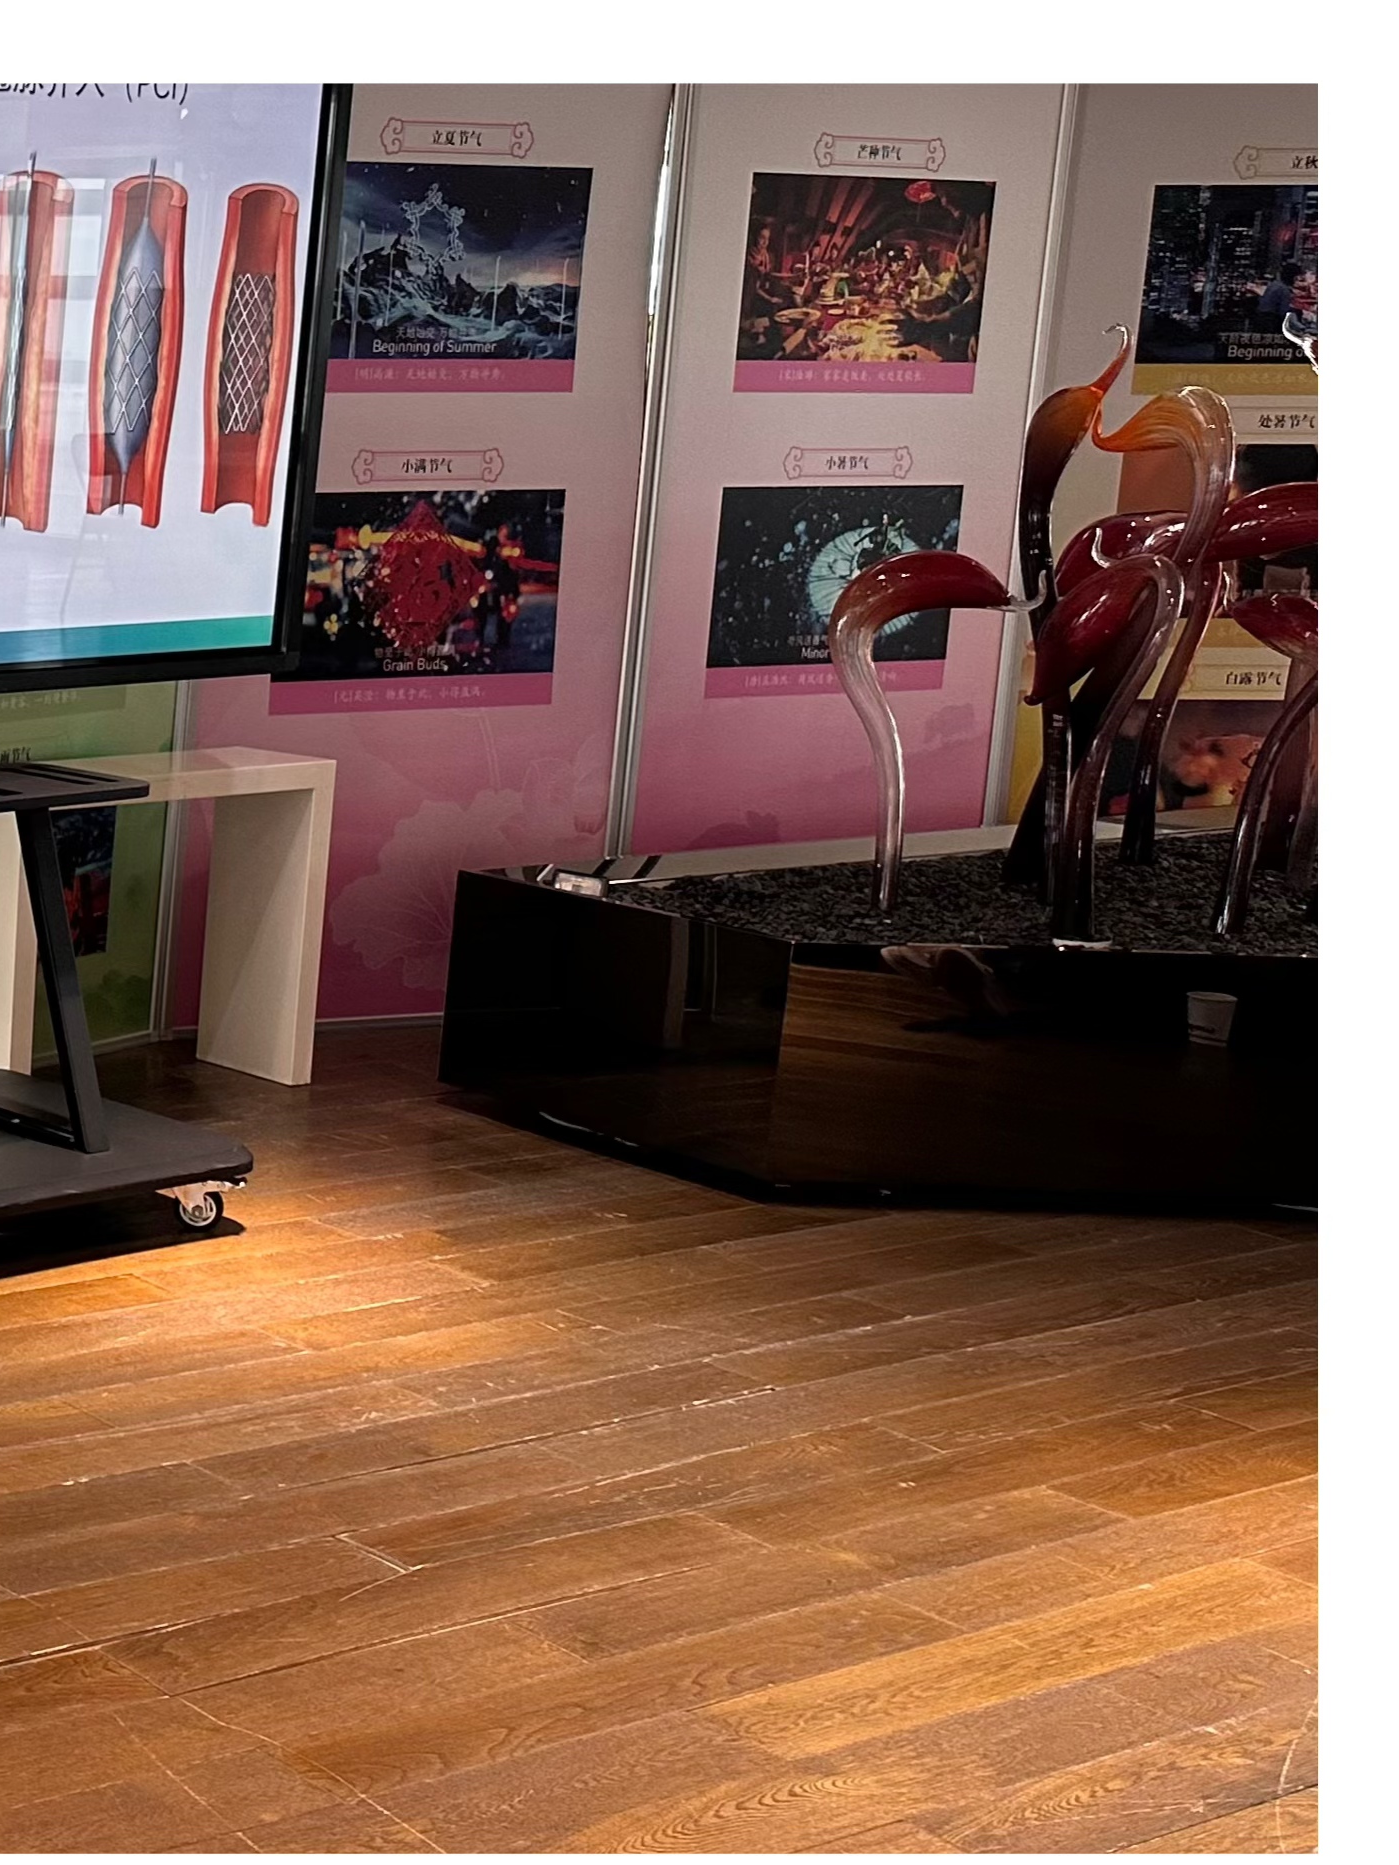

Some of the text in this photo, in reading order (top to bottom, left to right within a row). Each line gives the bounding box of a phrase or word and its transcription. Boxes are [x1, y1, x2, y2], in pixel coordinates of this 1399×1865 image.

[431, 129, 483, 147] 立夏节气
[372, 339, 497, 356] Beginning of Summer
[1227, 345, 1294, 361] Beginning
[401, 457, 454, 475] 小满节气
[800, 647, 830, 660] Minor
[382, 657, 446, 673] Grain Buds
